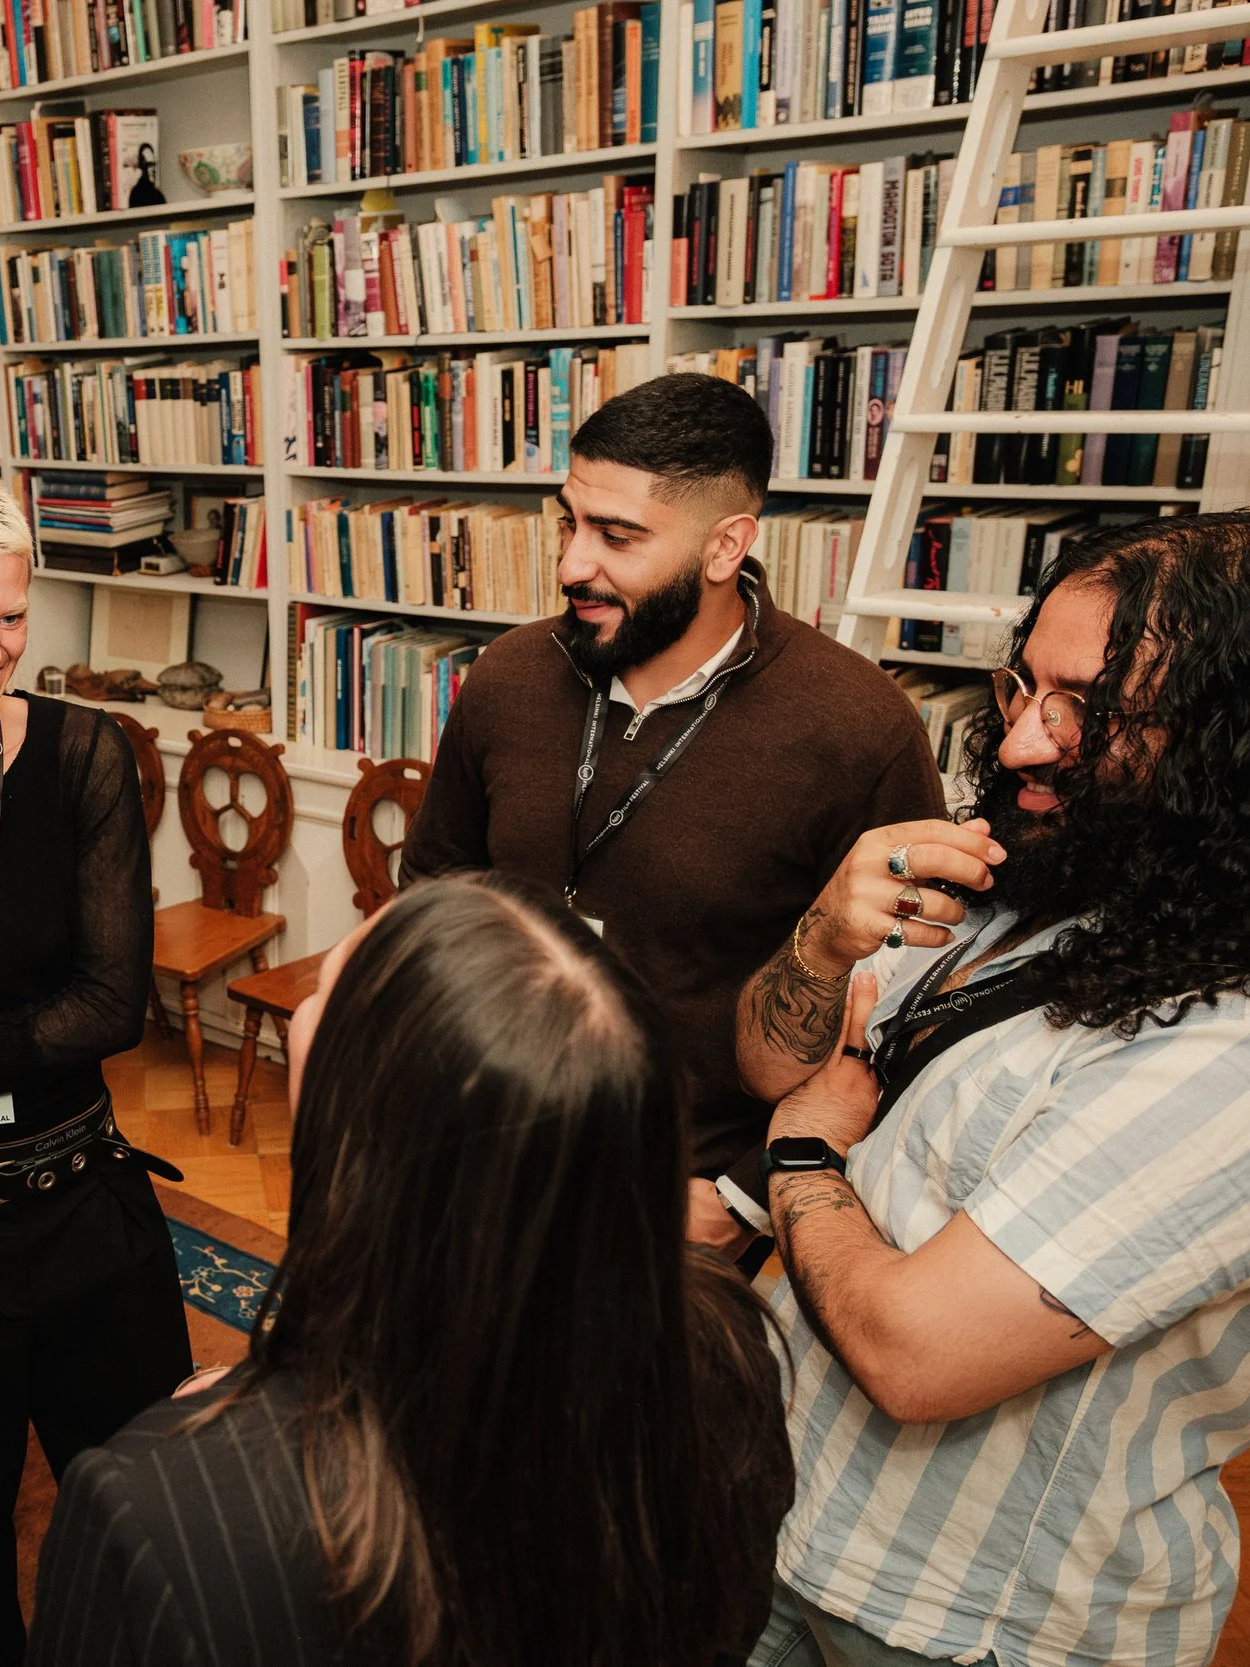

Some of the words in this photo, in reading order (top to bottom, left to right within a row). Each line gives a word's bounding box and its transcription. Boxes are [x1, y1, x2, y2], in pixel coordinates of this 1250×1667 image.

[594, 692, 602, 719] HELSINKI
[584, 720, 597, 765] INTERNATIONAL
[655, 747, 676, 771] HELSINKI
[674, 709, 708, 749] INTERNATIONAL
[629, 779, 649, 802] FESTIVAL
[934, 1001, 952, 1012] FILM
[35, 1134, 65, 1152] Calvin
[65, 1124, 86, 1140] Klein
